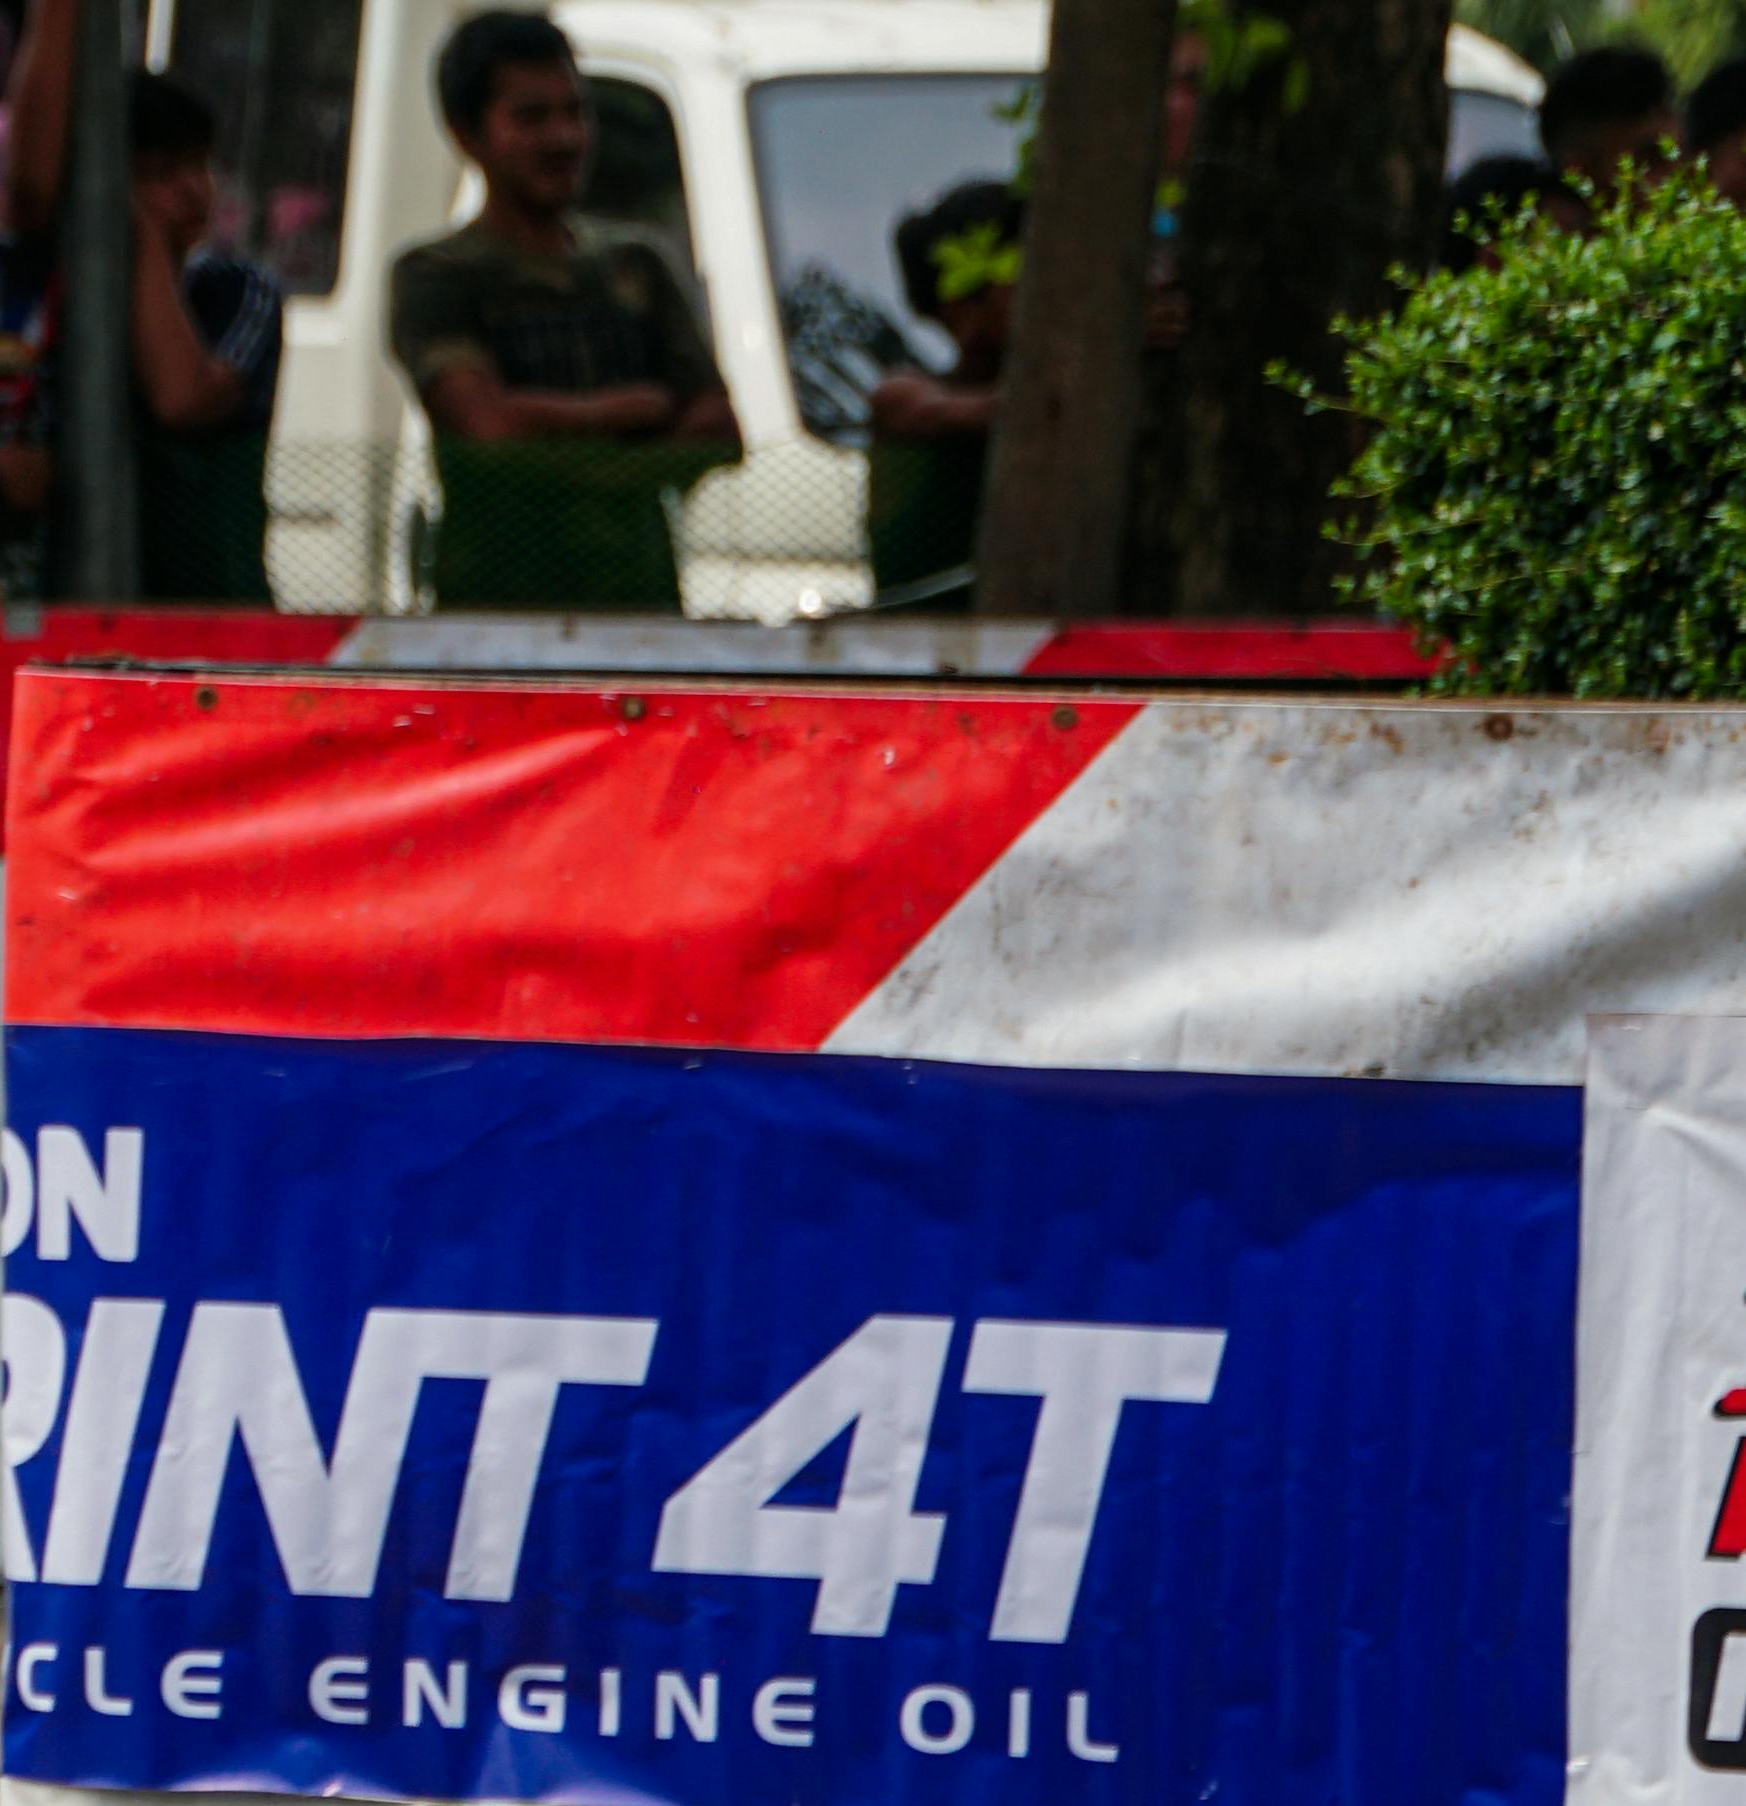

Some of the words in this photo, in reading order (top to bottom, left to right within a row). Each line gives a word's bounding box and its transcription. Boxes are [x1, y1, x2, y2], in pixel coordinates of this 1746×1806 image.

[651, 1313, 1227, 1645] 4T
[309, 1656, 816, 1748] ENGINE
[899, 1683, 1119, 1763] OIL
